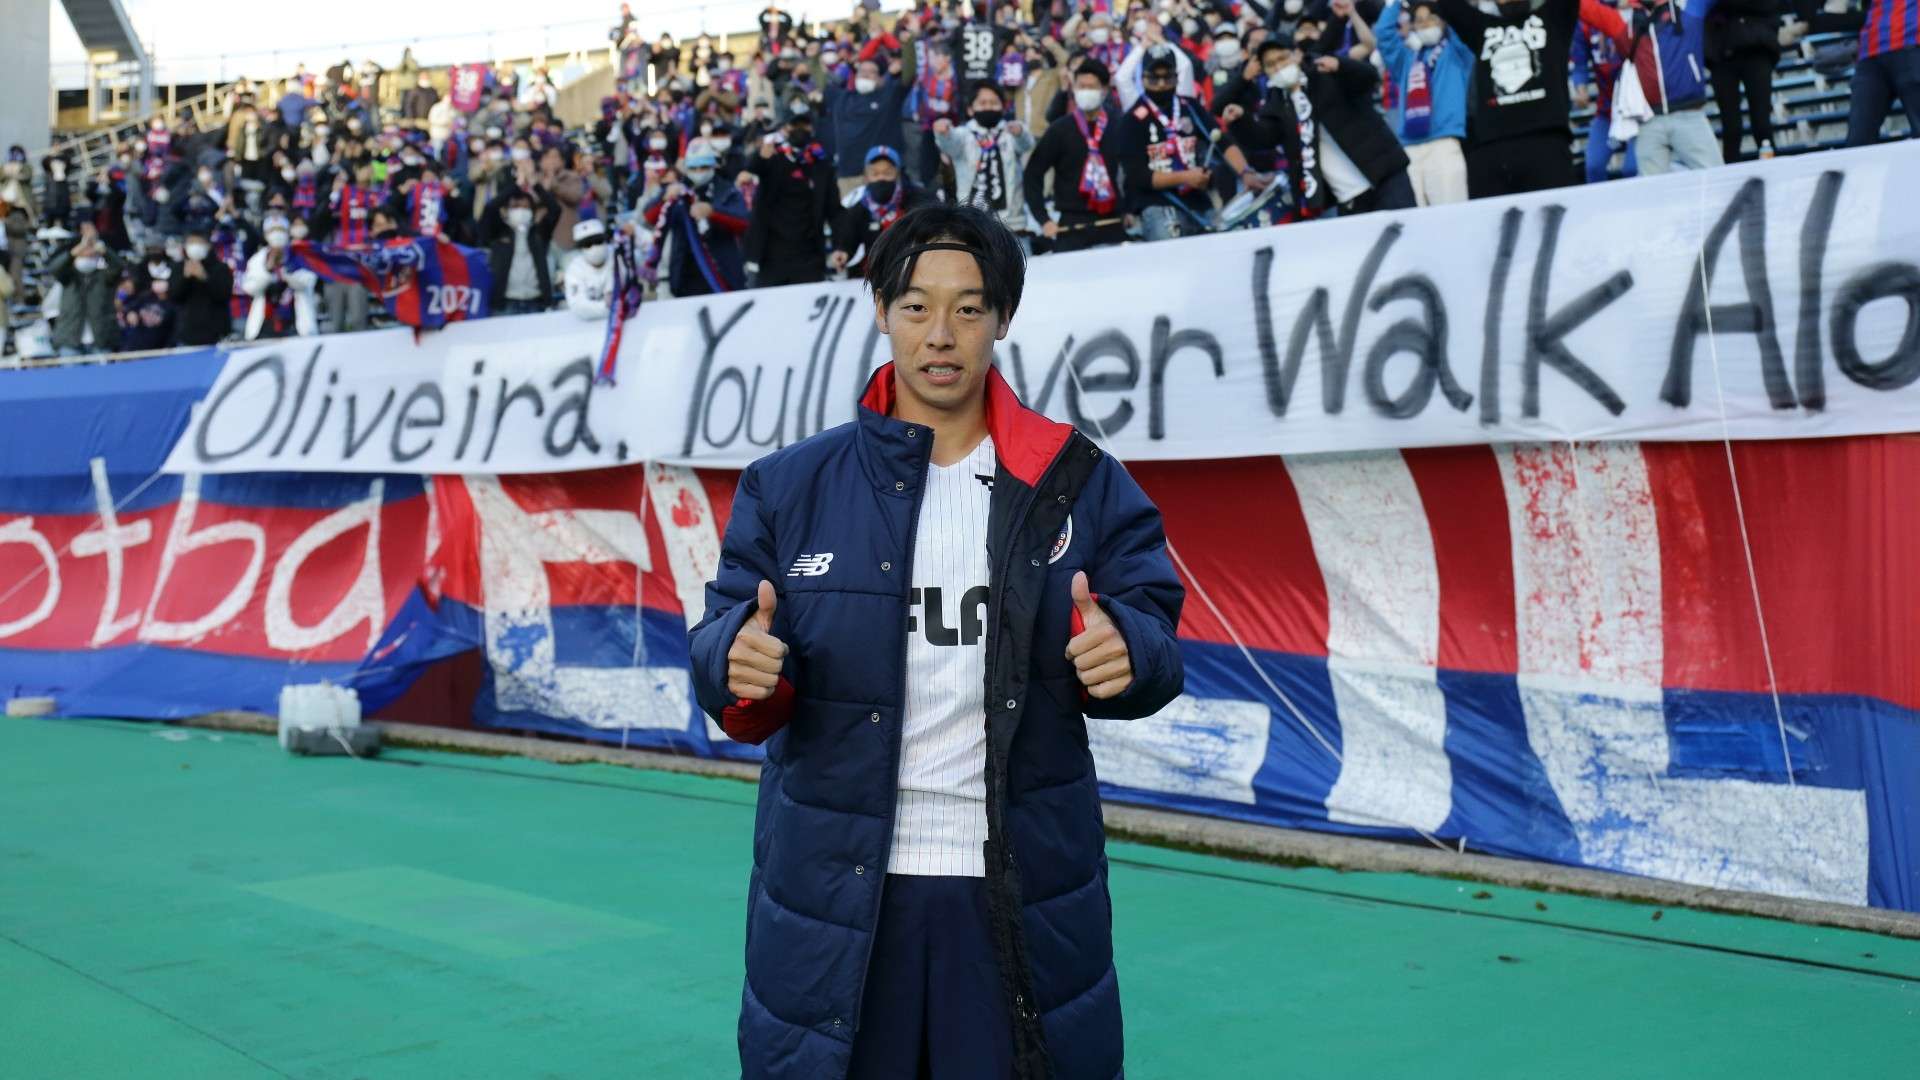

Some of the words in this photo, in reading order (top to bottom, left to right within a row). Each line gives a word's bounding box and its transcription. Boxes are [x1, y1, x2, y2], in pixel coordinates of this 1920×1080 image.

[963, 31, 993, 62] 38
[426, 285, 482, 316] 2021
[1252, 204, 1635, 427] Walk
